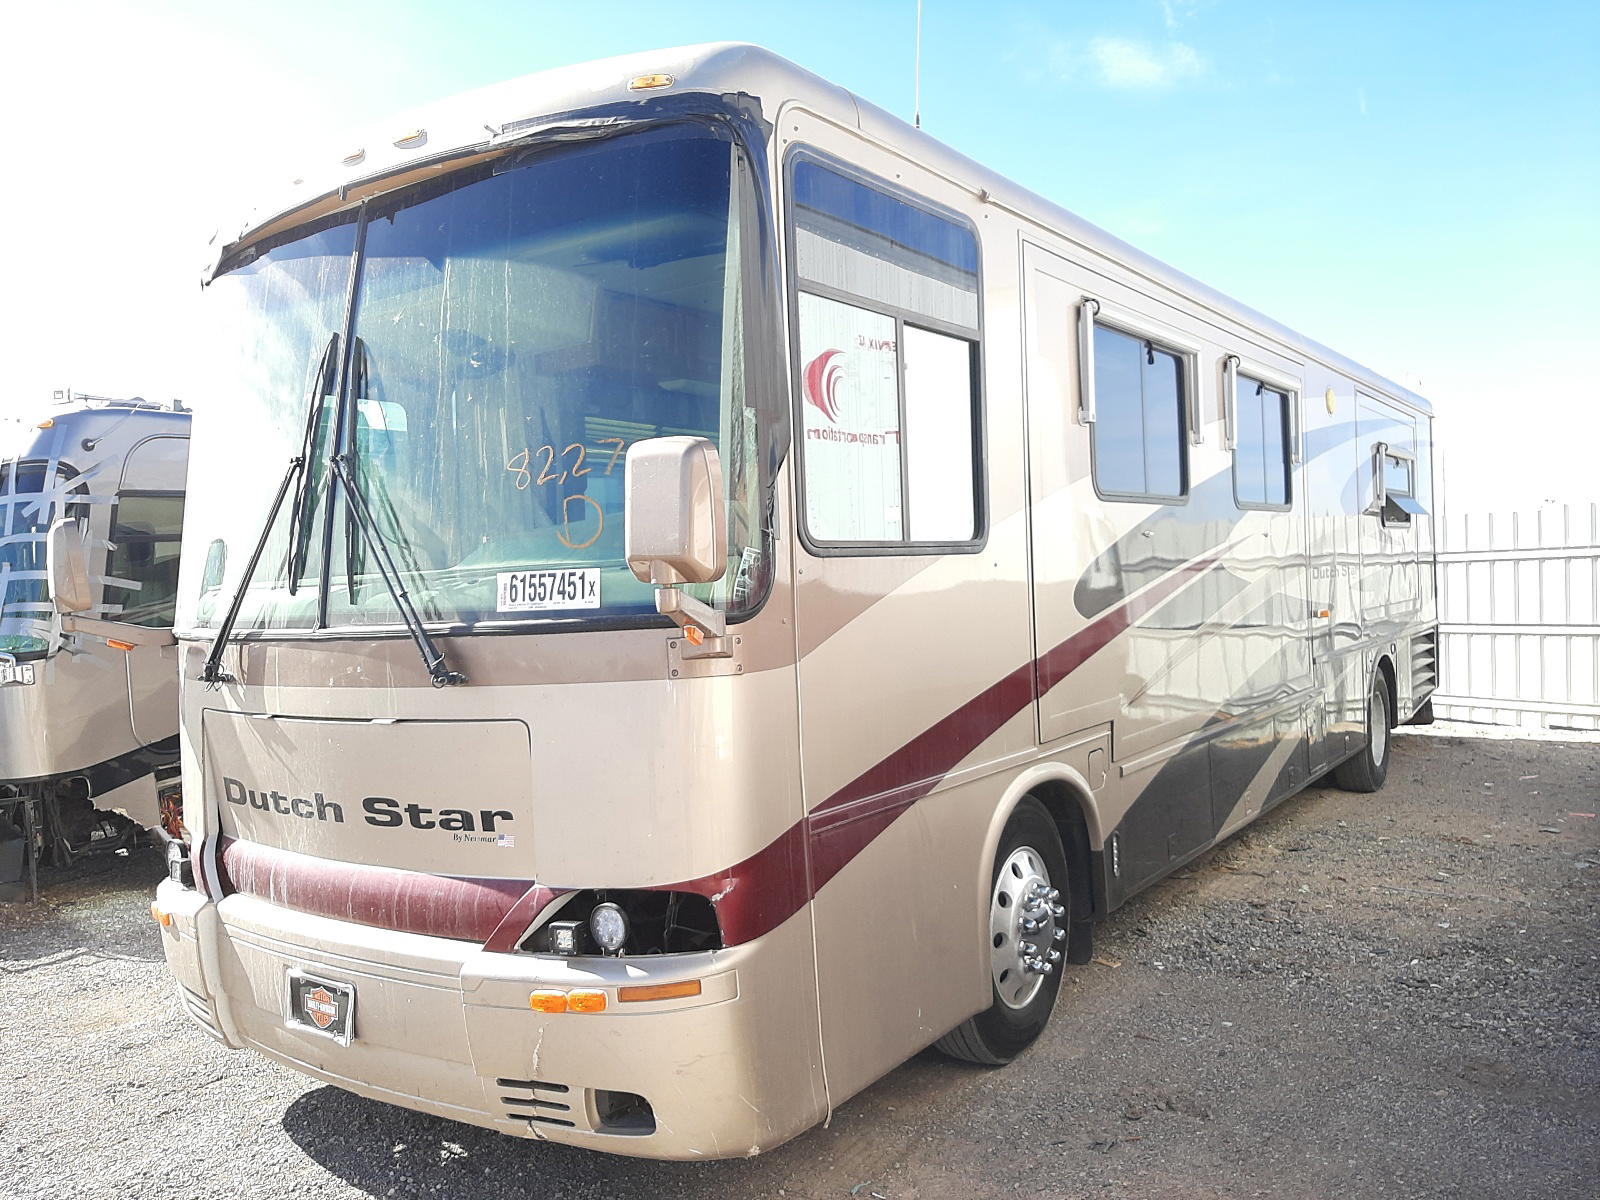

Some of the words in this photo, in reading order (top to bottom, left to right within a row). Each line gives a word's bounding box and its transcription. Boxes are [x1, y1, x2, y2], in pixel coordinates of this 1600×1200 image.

[509, 571, 585, 602] 61557451
[223, 776, 345, 823] Dutch
[361, 797, 514, 832] Star
[453, 833, 463, 843] By
